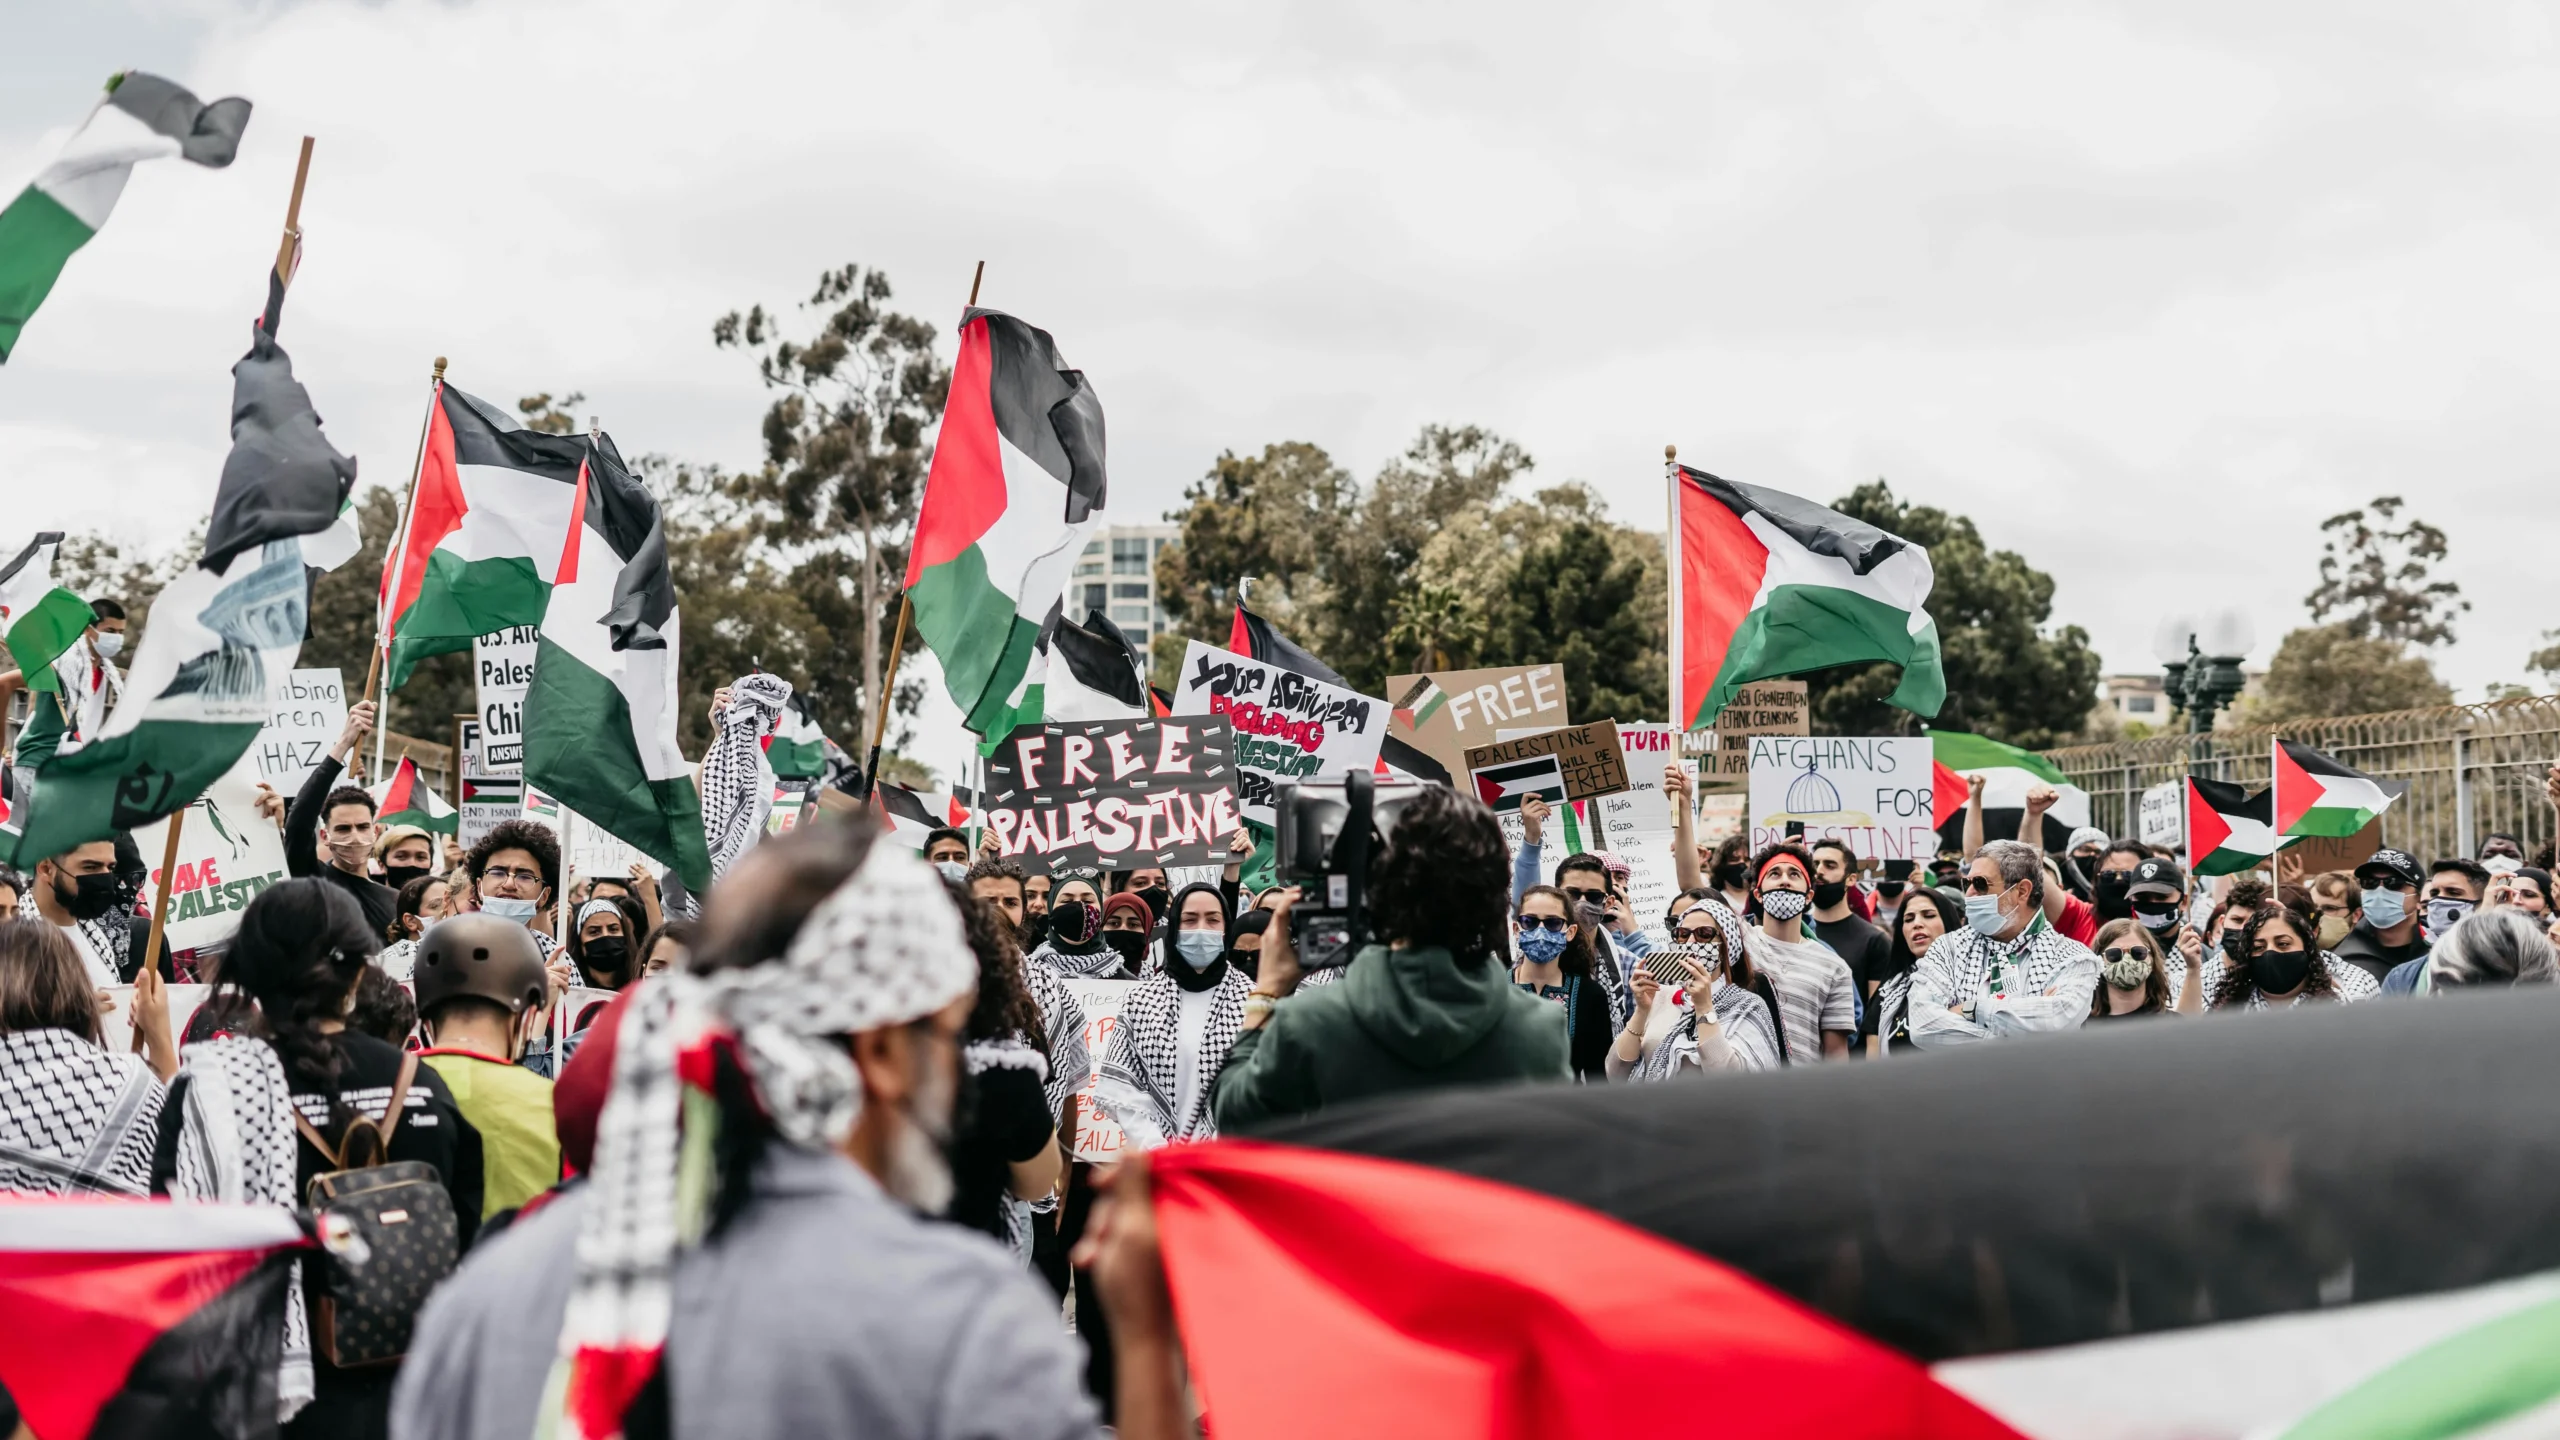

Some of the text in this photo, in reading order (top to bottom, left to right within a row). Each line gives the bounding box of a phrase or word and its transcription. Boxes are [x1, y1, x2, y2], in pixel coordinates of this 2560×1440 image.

[1448, 666, 1558, 732] FREE
[1473, 728, 1595, 766] PALESTINE
[1682, 730, 1718, 752] ANTI
[1015, 723, 1193, 790] FREE
[1559, 749, 1613, 769] WILL BE
[1751, 739, 1896, 773] AFGHANS
[1561, 760, 1627, 797] FREE!
[462, 807, 485, 818] END
[1606, 799, 1632, 813] Haifa
[1877, 788, 1933, 817] FOR
[988, 787, 1241, 857] PALESTINE
[1609, 819, 1634, 832] Gaza
[1614, 837, 1641, 850] Yaffa
